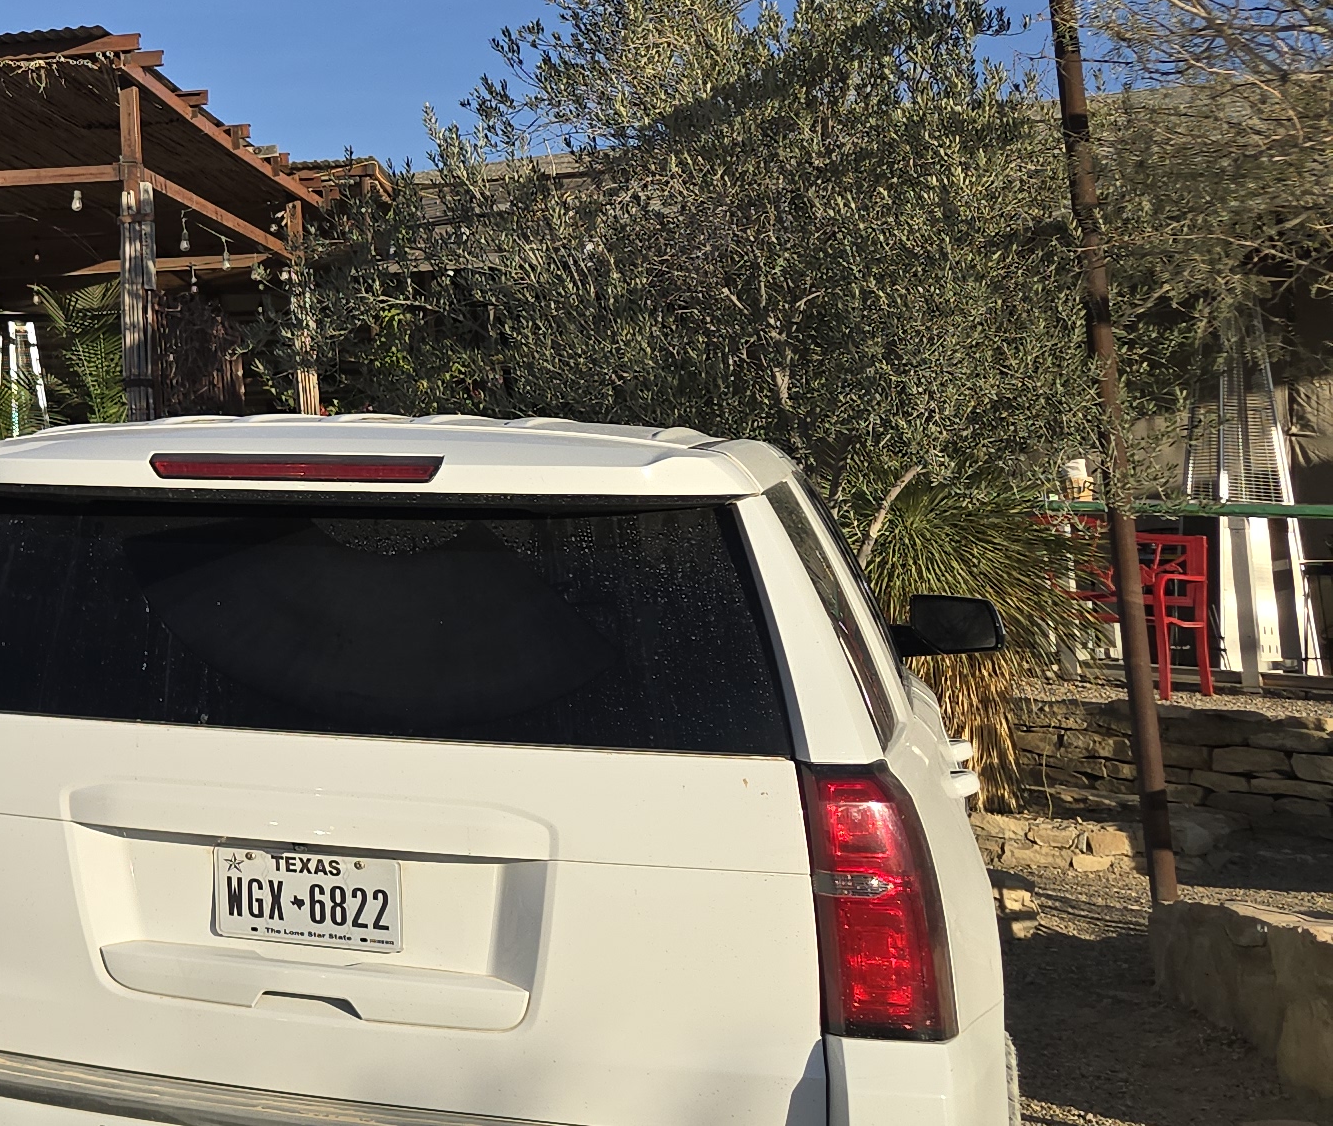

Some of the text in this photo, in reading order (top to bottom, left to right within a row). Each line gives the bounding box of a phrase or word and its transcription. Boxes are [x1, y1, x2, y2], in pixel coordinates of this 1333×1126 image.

[270, 854, 342, 877] TEXAS
[226, 875, 390, 931] WGX 6822
[264, 926, 352, 942] The Lone Star State
